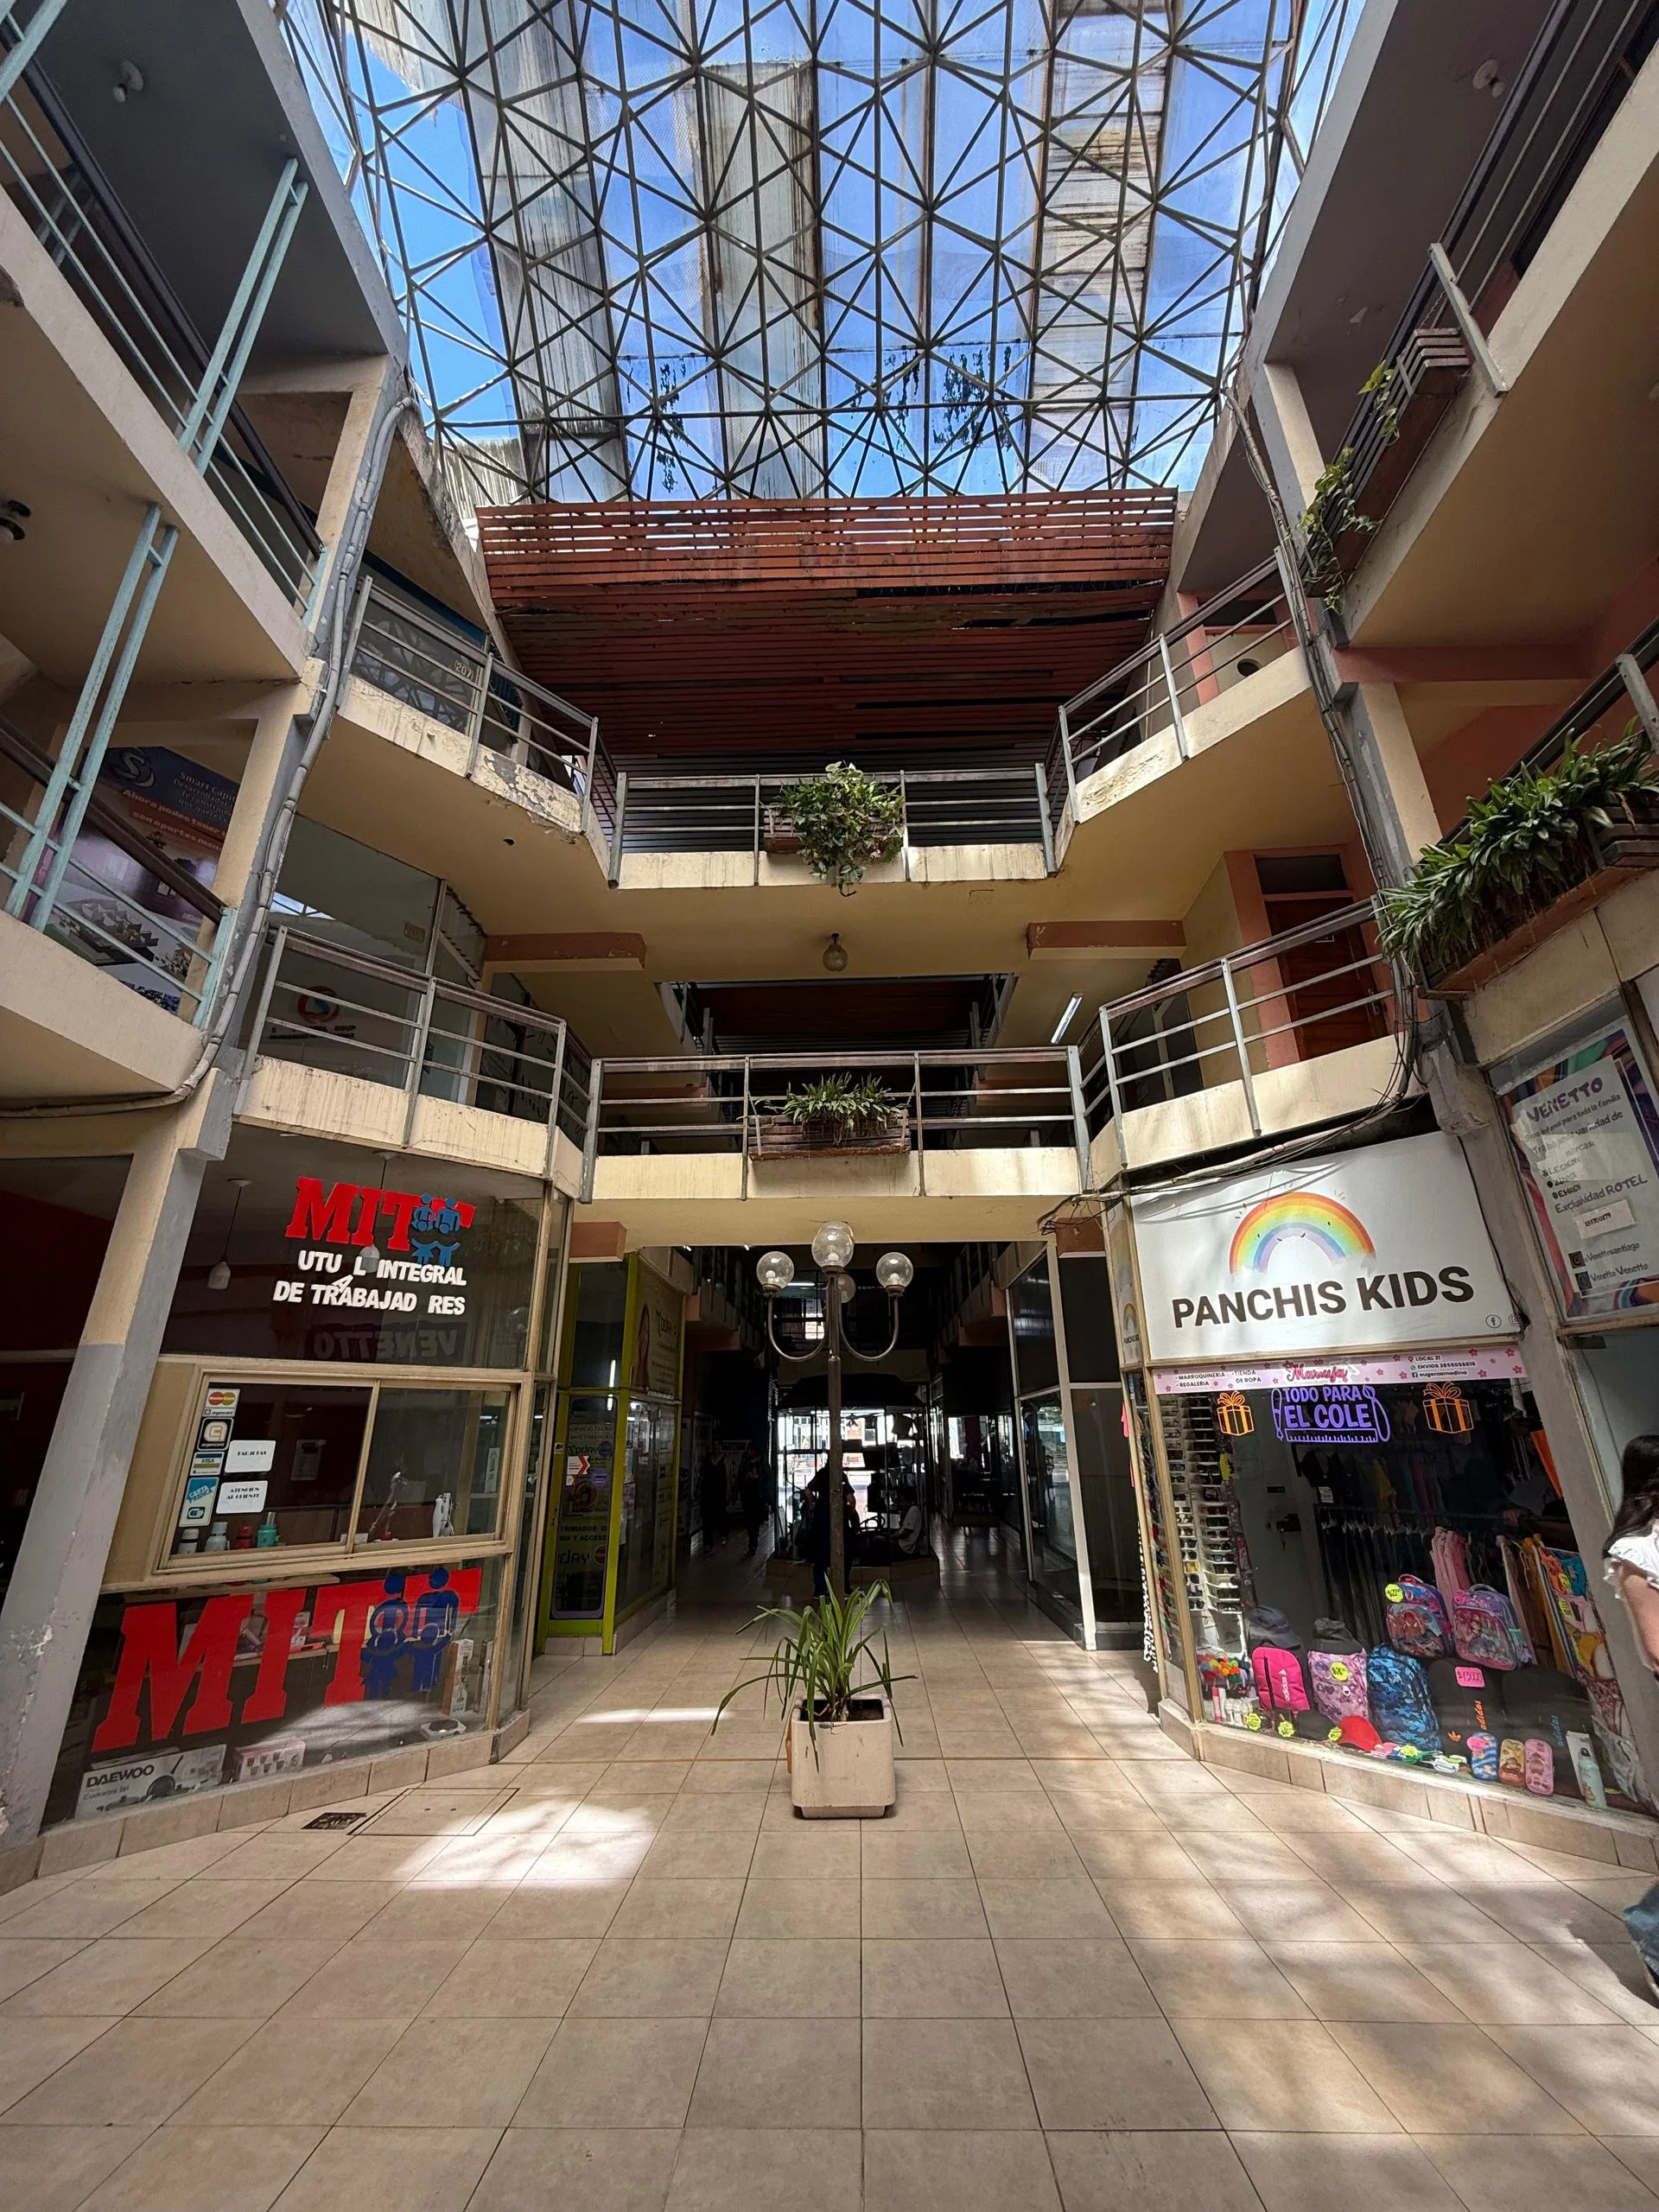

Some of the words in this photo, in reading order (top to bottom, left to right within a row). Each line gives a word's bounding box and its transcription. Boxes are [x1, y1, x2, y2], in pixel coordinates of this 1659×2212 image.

[455, 662, 473, 678] 207
[122, 788, 157, 808] Ahora
[1526, 1077, 1603, 1122] VENETTO
[1562, 1113, 1578, 1127] para
[1598, 1093, 1622, 1109] familia
[1611, 1109, 1624, 1122] de
[1554, 1187, 1605, 1214] Exclusividad
[1605, 1173, 1648, 1196] ROTEL
[376, 1259, 467, 1287] INTEGRAL
[1589, 1270, 1616, 1282] Venetto
[1615, 1262, 1649, 1275] Venetto
[272, 1280, 305, 1303] DE
[1171, 1281, 1347, 1329] PANCHIS
[1356, 1265, 1475, 1312] KIDS
[1284, 1387, 1319, 1402] TODO
[1322, 1385, 1363, 1402] PARA
[1283, 1404, 1310, 1428] EL
[1313, 1403, 1373, 1429] COLE
[1473, 1700, 1488, 1731] adidas
[1550, 1713, 1565, 1747] adidas
[86, 1764, 155, 1789] DAEWOO
